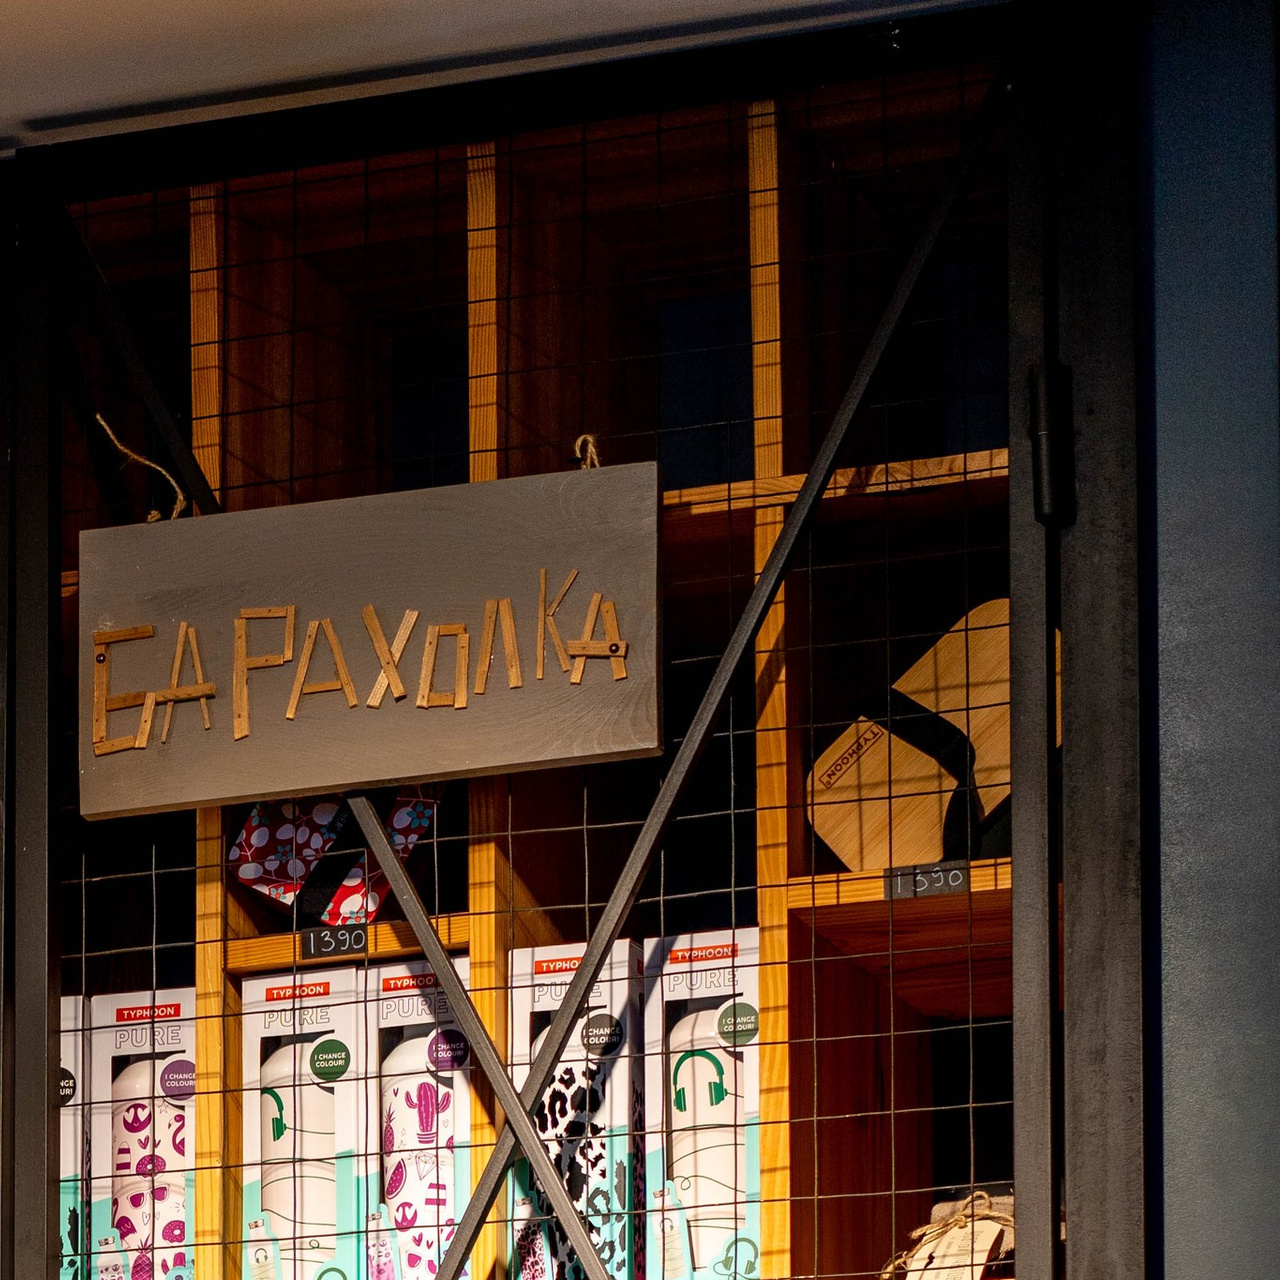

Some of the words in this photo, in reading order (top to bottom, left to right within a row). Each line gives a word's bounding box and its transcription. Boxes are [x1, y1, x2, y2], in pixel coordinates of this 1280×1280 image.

[91, 569, 630, 756] БАРАХОЛКА
[896, 868, 963, 893] 1390
[309, 930, 366, 954] 1390
[677, 948, 732, 960] TYPHOON
[541, 960, 582, 972] TYPHO
[389, 977, 434, 989] TYPHOO
[534, 978, 601, 1002] PUE
[668, 968, 738, 992] PURE
[272, 985, 324, 999] TYPHOON
[123, 1007, 175, 1019] TYPHOON
[264, 1007, 331, 1029] PURE
[382, 994, 449, 1020] PURE
[115, 1025, 181, 1049] PURE
[318, 1052, 346, 1060] CHANGE
